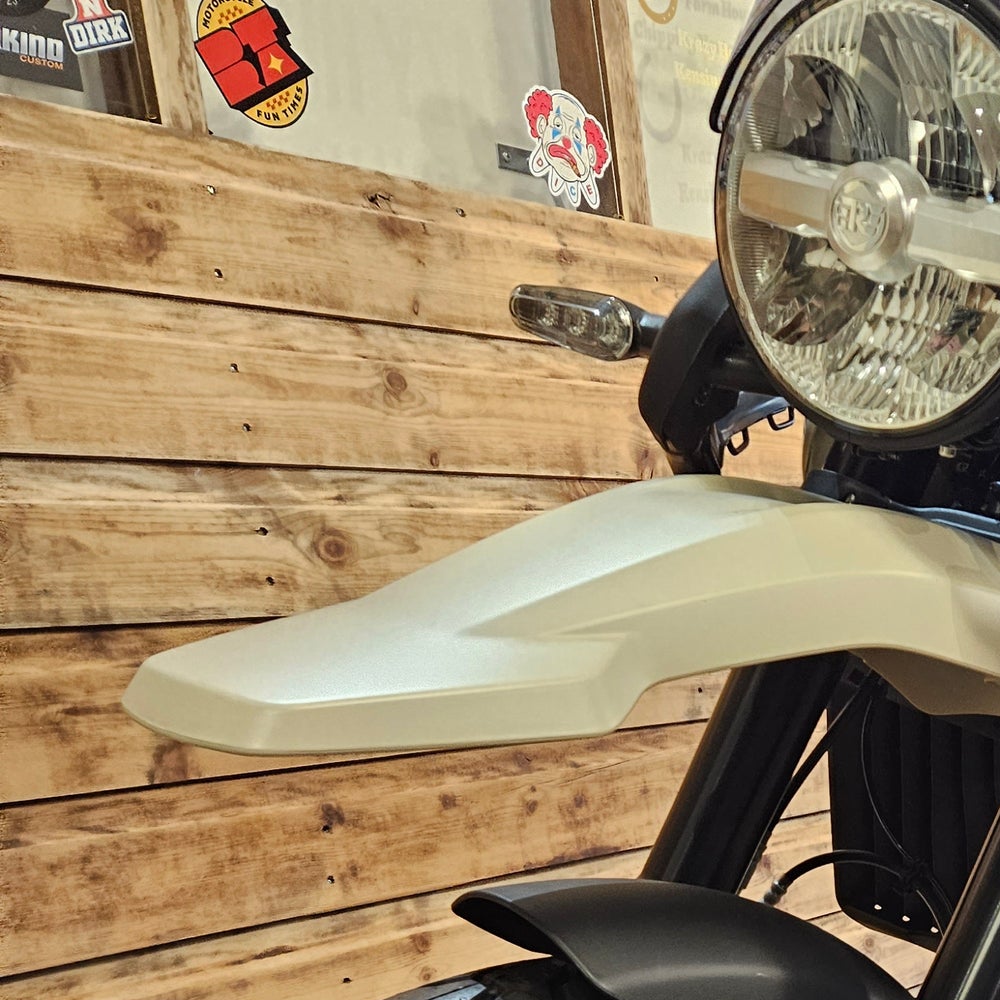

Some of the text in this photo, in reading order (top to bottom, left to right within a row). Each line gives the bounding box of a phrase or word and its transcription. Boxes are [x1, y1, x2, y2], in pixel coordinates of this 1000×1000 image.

[0, 27, 64, 62] KIND
[68, 15, 129, 48] DIRK
[20, 54, 64, 70] CUSTOM
[256, 85, 303, 121] FUN TIMES
